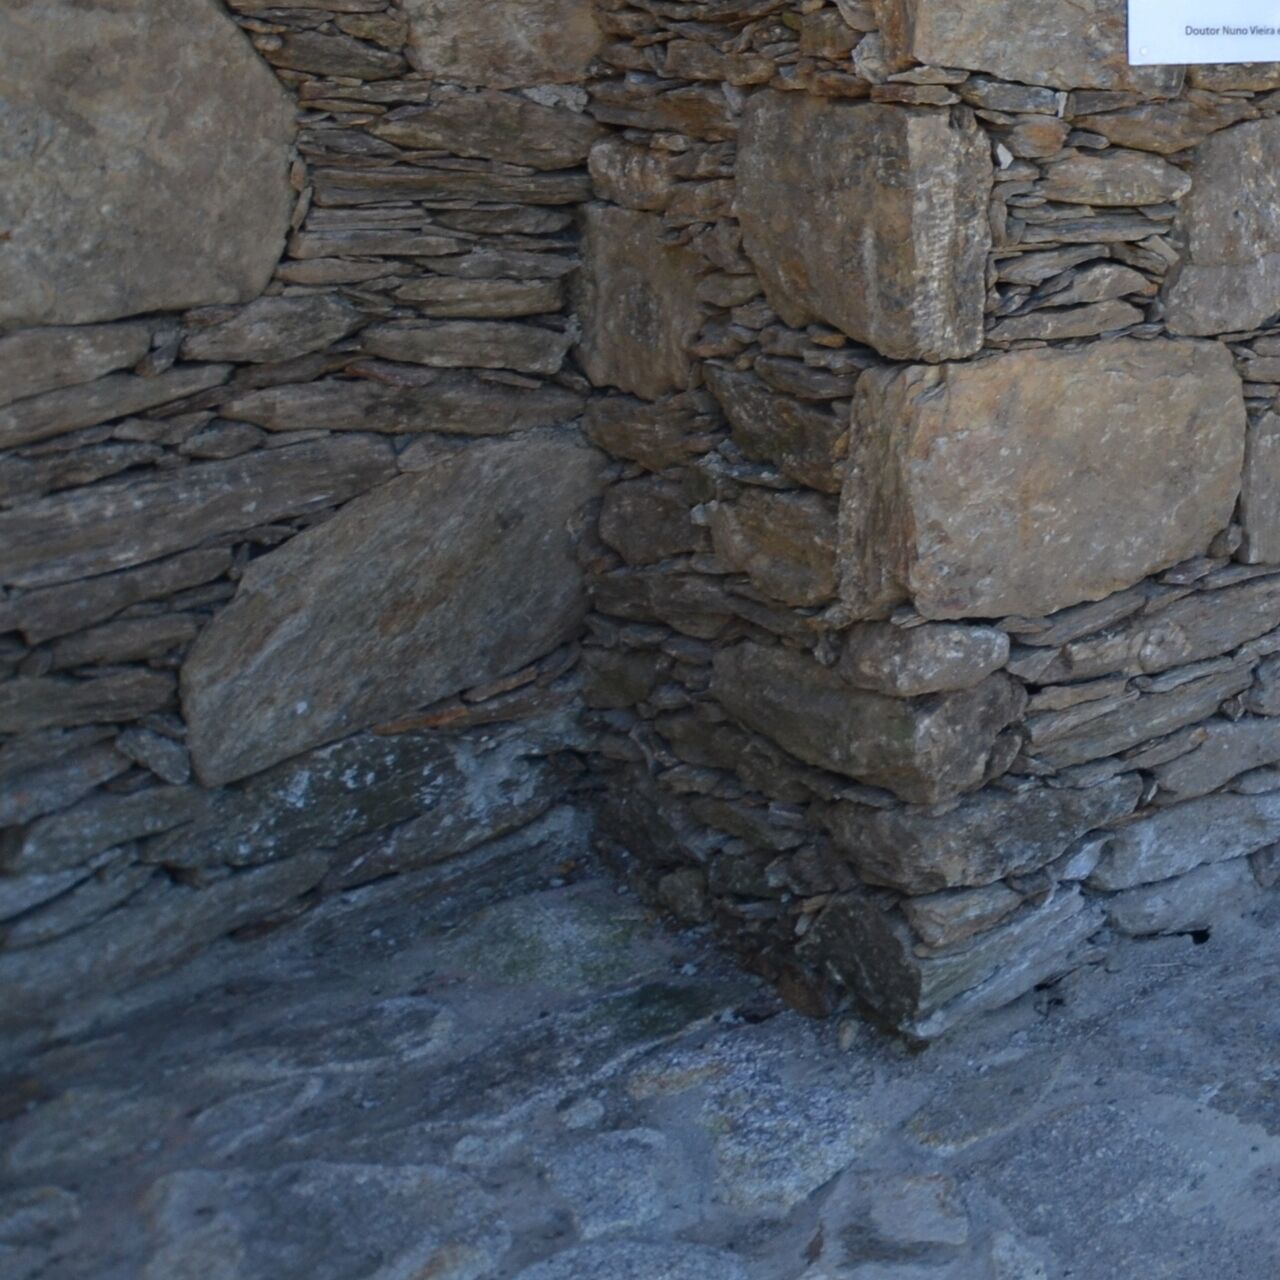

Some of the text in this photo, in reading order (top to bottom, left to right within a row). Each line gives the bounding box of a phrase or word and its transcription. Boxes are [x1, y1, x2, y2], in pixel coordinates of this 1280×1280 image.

[1185, 25, 1220, 36] Doutor
[1222, 25, 1248, 35] Nuno
[1249, 25, 1275, 35] Vieira
